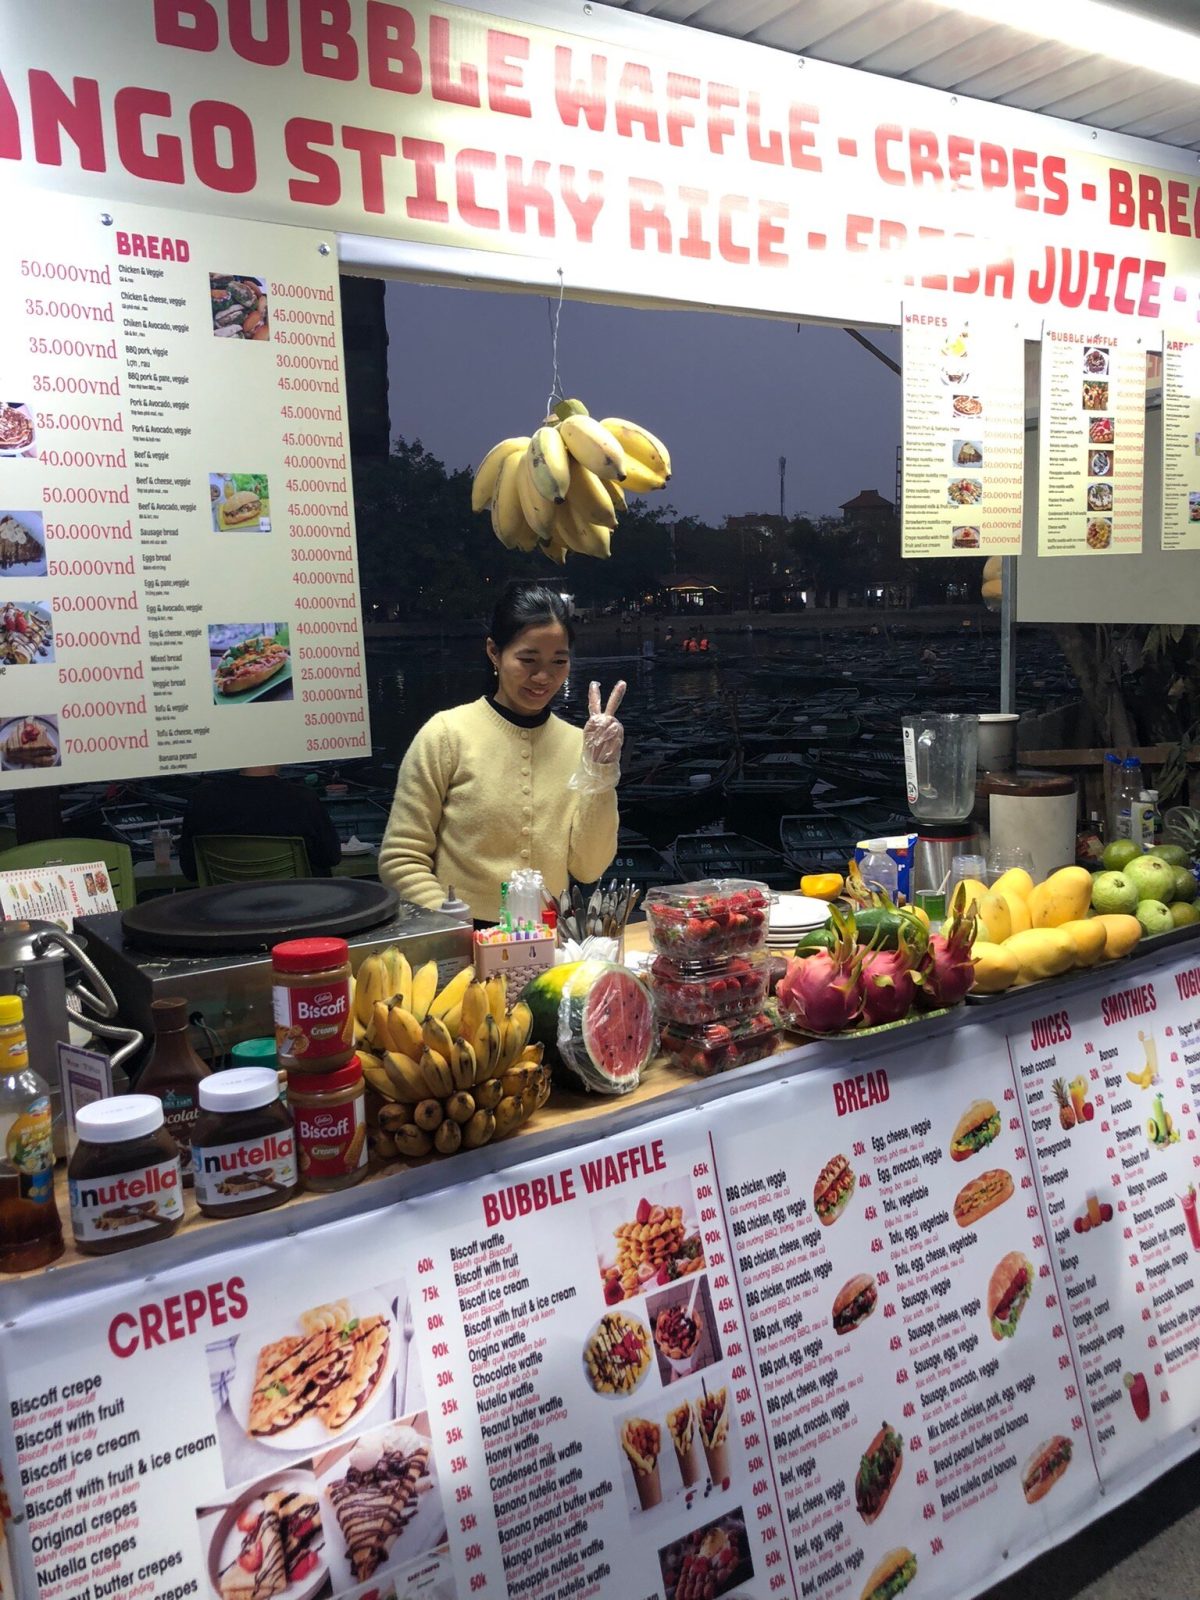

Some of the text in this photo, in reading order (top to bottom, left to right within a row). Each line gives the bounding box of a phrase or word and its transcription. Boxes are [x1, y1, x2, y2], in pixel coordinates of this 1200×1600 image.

[154, 0, 532, 118] BUBBLE
[555, 45, 822, 172] WAFFLE
[874, 124, 1069, 216] CREPES
[1109, 167, 1200, 239] BRE
[284, 117, 604, 243] STICKY
[628, 176, 790, 268] RICE
[1028, 245, 1166, 318] JUICE
[116, 231, 190, 263] BREAD
[21, 260, 112, 285] 50.000vnd
[118, 264, 141, 276] Chicken
[146, 267, 164, 278] Veggie
[121, 292, 142, 303] Chicken
[169, 297, 187, 307] veggie
[271, 282, 335, 302] 30.000vnd
[25, 298, 115, 323] 35.000vnd
[272, 308, 336, 327] 45.000vnd
[29, 336, 118, 360] 35.000vnd
[274, 331, 337, 348] 45.000vnd
[1050, 331, 1118, 347] BUBBLE WAFFLE
[125, 345, 138, 355] BBQ
[276, 354, 339, 372] 30.000vnd
[32, 374, 121, 396] 35.000vnd
[36, 412, 124, 432] 35.000vnd
[39, 448, 127, 468] 40.000vnd
[134, 450, 146, 460] Beef
[152, 451, 169, 461] veggie
[42, 484, 130, 504] 50.000vnd
[285, 477, 347, 493] 45.000vnd
[46, 520, 133, 540] 50.000vnd
[140, 528, 179, 538] Sausage bread
[142, 554, 171, 563] Eggs bread
[292, 568, 355, 585] 40.000vnd
[52, 590, 139, 612] 50.000vnd
[150, 653, 182, 663] Mixed bread
[300, 662, 362, 680] 25.000vnd
[152, 678, 186, 689] Veggie bread
[61, 694, 148, 720] 60.000vnd
[304, 706, 365, 727] 35.000vnd
[65, 729, 150, 755] 70.000vnd
[306, 732, 366, 752] 35.000vnd
[298, 995, 346, 1019] Biscoff
[1101, 983, 1157, 1027] SMOTHIES
[310, 1025, 339, 1037] Creamy
[1031, 1010, 1072, 1051] JUICES
[1020, 1054, 1057, 1077] Fresh coconut
[833, 1068, 890, 1117] BREAD
[1026, 1089, 1044, 1106] Lemon
[164, 1108, 200, 1124] colat
[1031, 1116, 1052, 1133] Orange
[300, 1117, 350, 1139] Biscoff
[871, 1117, 932, 1152] Egg, cheese, veggie
[204, 1136, 293, 1174] nutella
[311, 1145, 340, 1157] Creamy
[852, 1142, 866, 1157] 30k
[693, 1162, 709, 1178] 65k
[1042, 1167, 1069, 1188] Pineapple
[81, 1167, 177, 1208] nutella
[482, 1139, 667, 1228] BUBBLE WAFFLE
[696, 1184, 713, 1200] 80k
[725, 1168, 787, 1203] BBQ chicken, veggie
[858, 1173, 872, 1190] 40k
[898, 1185, 929, 1208] vegetable
[732, 1218, 747, 1237] BBQ
[747, 1210, 773, 1232] chicken,
[786, 1197, 807, 1218] veggie
[864, 1205, 878, 1222] 45k
[450, 1233, 505, 1261] Biscoff waffle
[705, 1229, 721, 1245] 90k
[417, 1257, 435, 1275] 60k
[454, 1252, 519, 1287] Biscoff with fruit
[709, 1251, 725, 1268] 30k
[422, 1285, 440, 1303] 75k
[459, 1278, 530, 1313] Biscoff ice cream
[930, 1277, 952, 1297] veggie
[718, 1296, 734, 1312] 45k
[107, 1276, 249, 1358] CREPES
[427, 1313, 445, 1331] 80k
[431, 1342, 450, 1359] 90k
[500, 1330, 526, 1351] waffle
[472, 1350, 543, 1388] Chocolate waffle
[10, 1374, 102, 1417] Biscoff crepe
[477, 1381, 534, 1415] Nutella waffle
[15, 1398, 125, 1452] Biscoff with fruit
[481, 1394, 563, 1440] Peanut butter waffle
[20, 1428, 141, 1487] Biscoff ice cream
[25, 1432, 217, 1520] Biscoff with fruit & ice cream
[940, 1455, 1018, 1508] Bread nutella and banana
[31, 1500, 138, 1552] Original crepes
[36, 1534, 137, 1588] Nutella crepes
[94, 1551, 183, 1598] butter crepes
